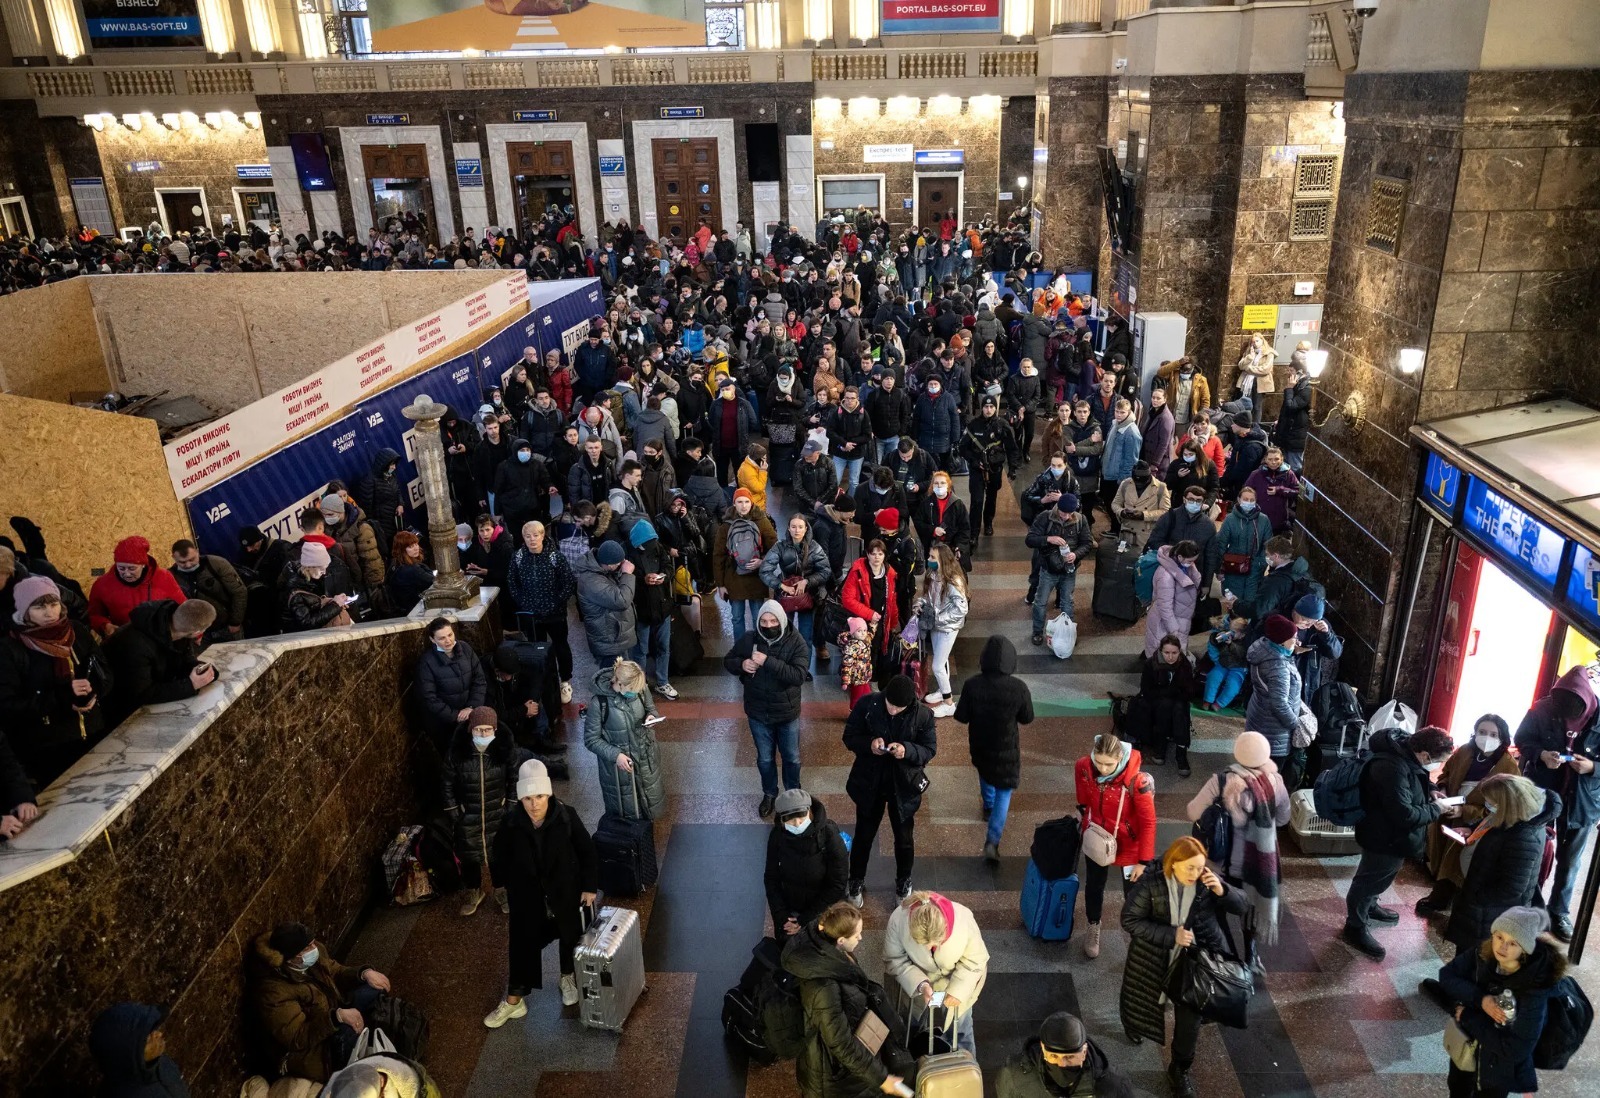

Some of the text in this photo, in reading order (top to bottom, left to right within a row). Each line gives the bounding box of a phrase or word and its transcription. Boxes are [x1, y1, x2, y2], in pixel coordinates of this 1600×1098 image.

[896, 4, 987, 13] PORTAL.BAS-SOFT.EU
[100, 22, 188, 31] WWW.BAS-SOFT.EU
[564, 332, 575, 348] ТУТ
[282, 378, 323, 404] РОБОТИ ВИКОНУЄ
[176, 422, 231, 457] РОБОТИ ВИКОНУЄ
[185, 440, 231, 470] МІЦУЇ УКРАЇНА
[182, 450, 242, 489] ЕСКАЛАТОРИ ЛІФТИ
[1475, 506, 1551, 574] THE PRESS
